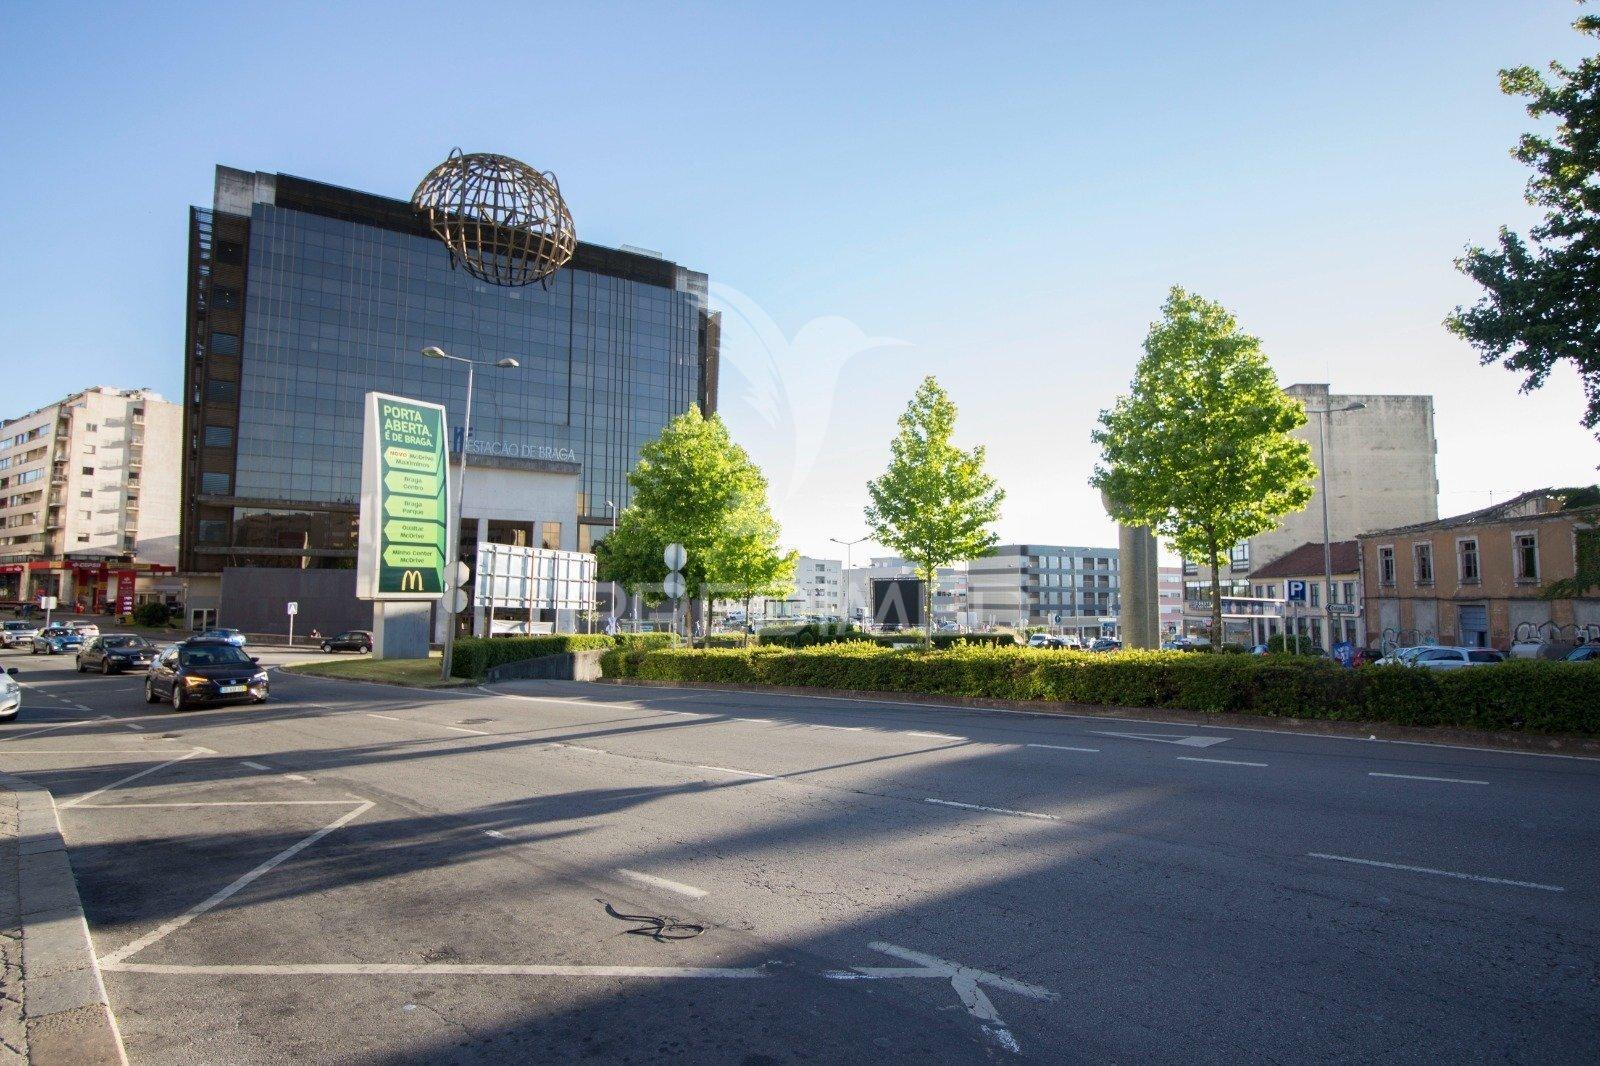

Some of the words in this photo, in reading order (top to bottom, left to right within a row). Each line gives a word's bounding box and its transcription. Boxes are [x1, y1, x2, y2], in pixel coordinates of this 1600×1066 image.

[383, 404, 423, 423] PORTA
[384, 418, 433, 438] ABERTA.
[384, 430, 391, 441] É
[391, 433, 403, 443] DE
[404, 434, 434, 448] BRAGA.
[521, 444, 536, 458] DE
[539, 446, 576, 462] BRAGA
[1290, 581, 1303, 597] P
